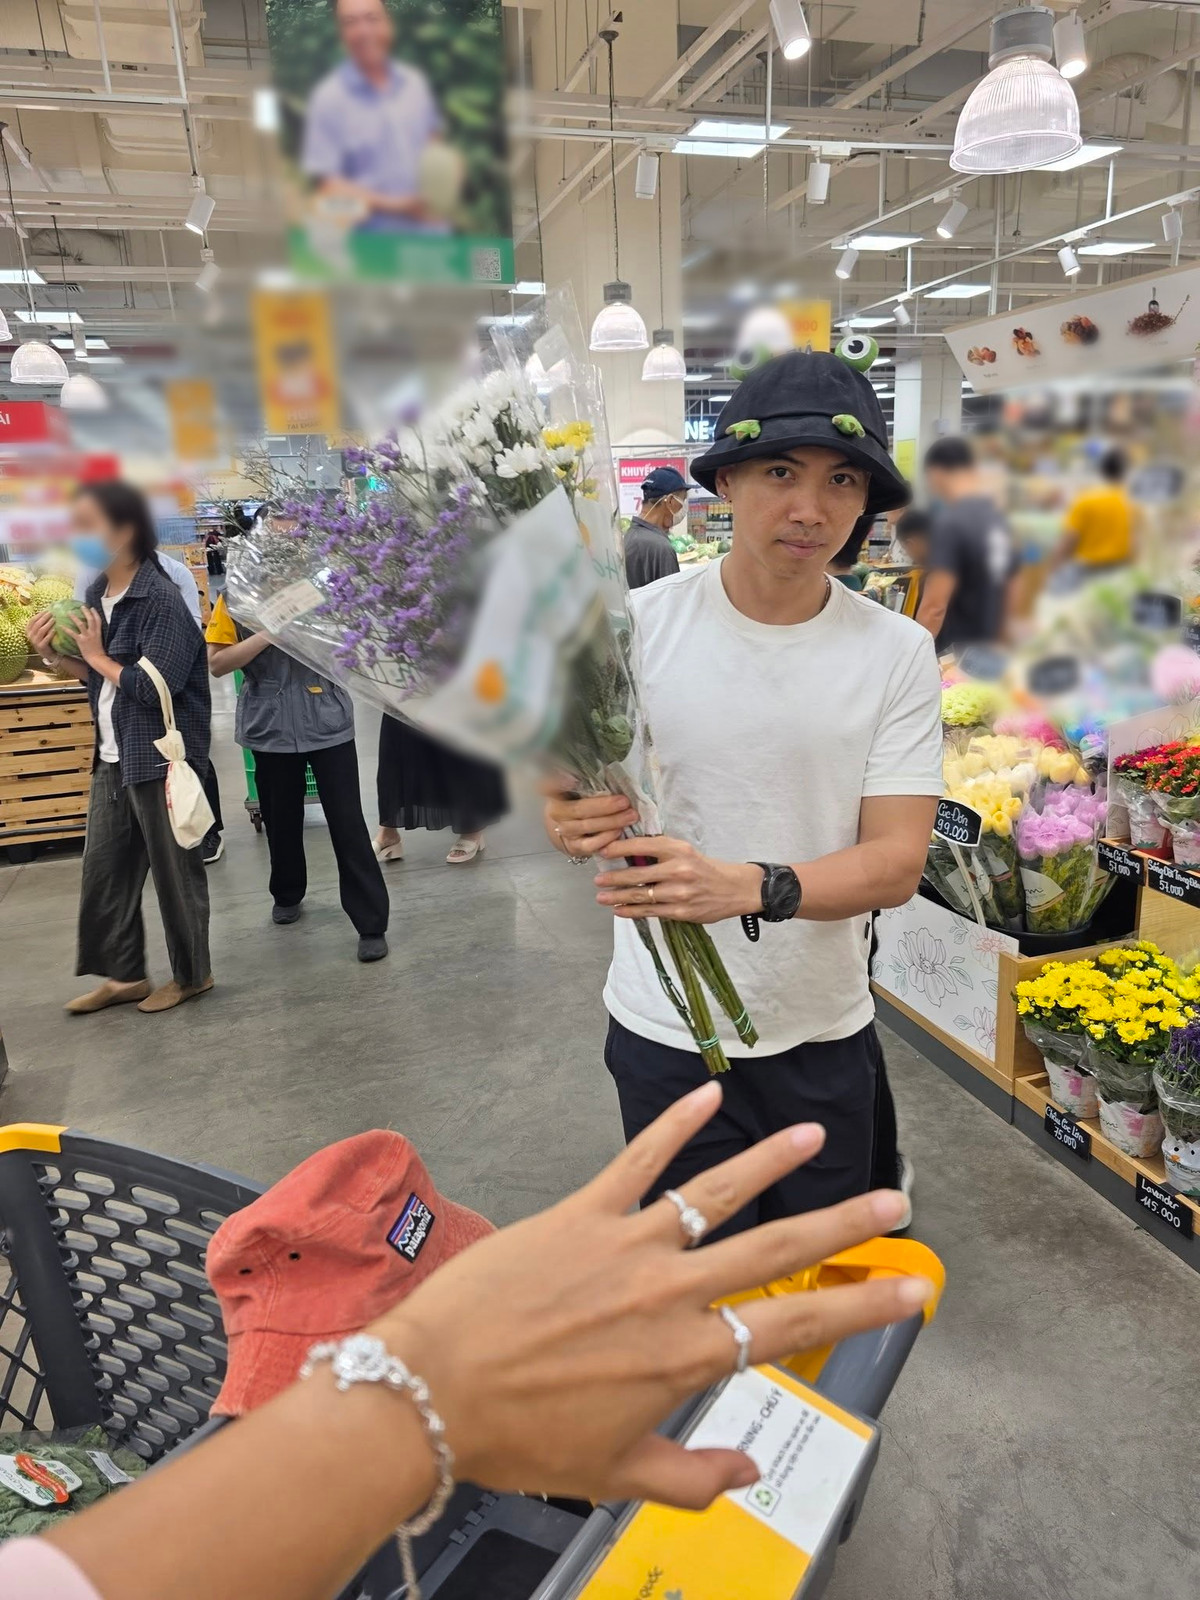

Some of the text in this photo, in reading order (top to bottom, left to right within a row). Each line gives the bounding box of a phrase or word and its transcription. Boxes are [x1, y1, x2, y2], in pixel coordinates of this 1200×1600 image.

[937, 818, 969, 842] 99.000
[1141, 1178, 1180, 1210] Lavender
[404, 1210, 433, 1258] patagonia
[736, 1419, 764, 1452] RNING
